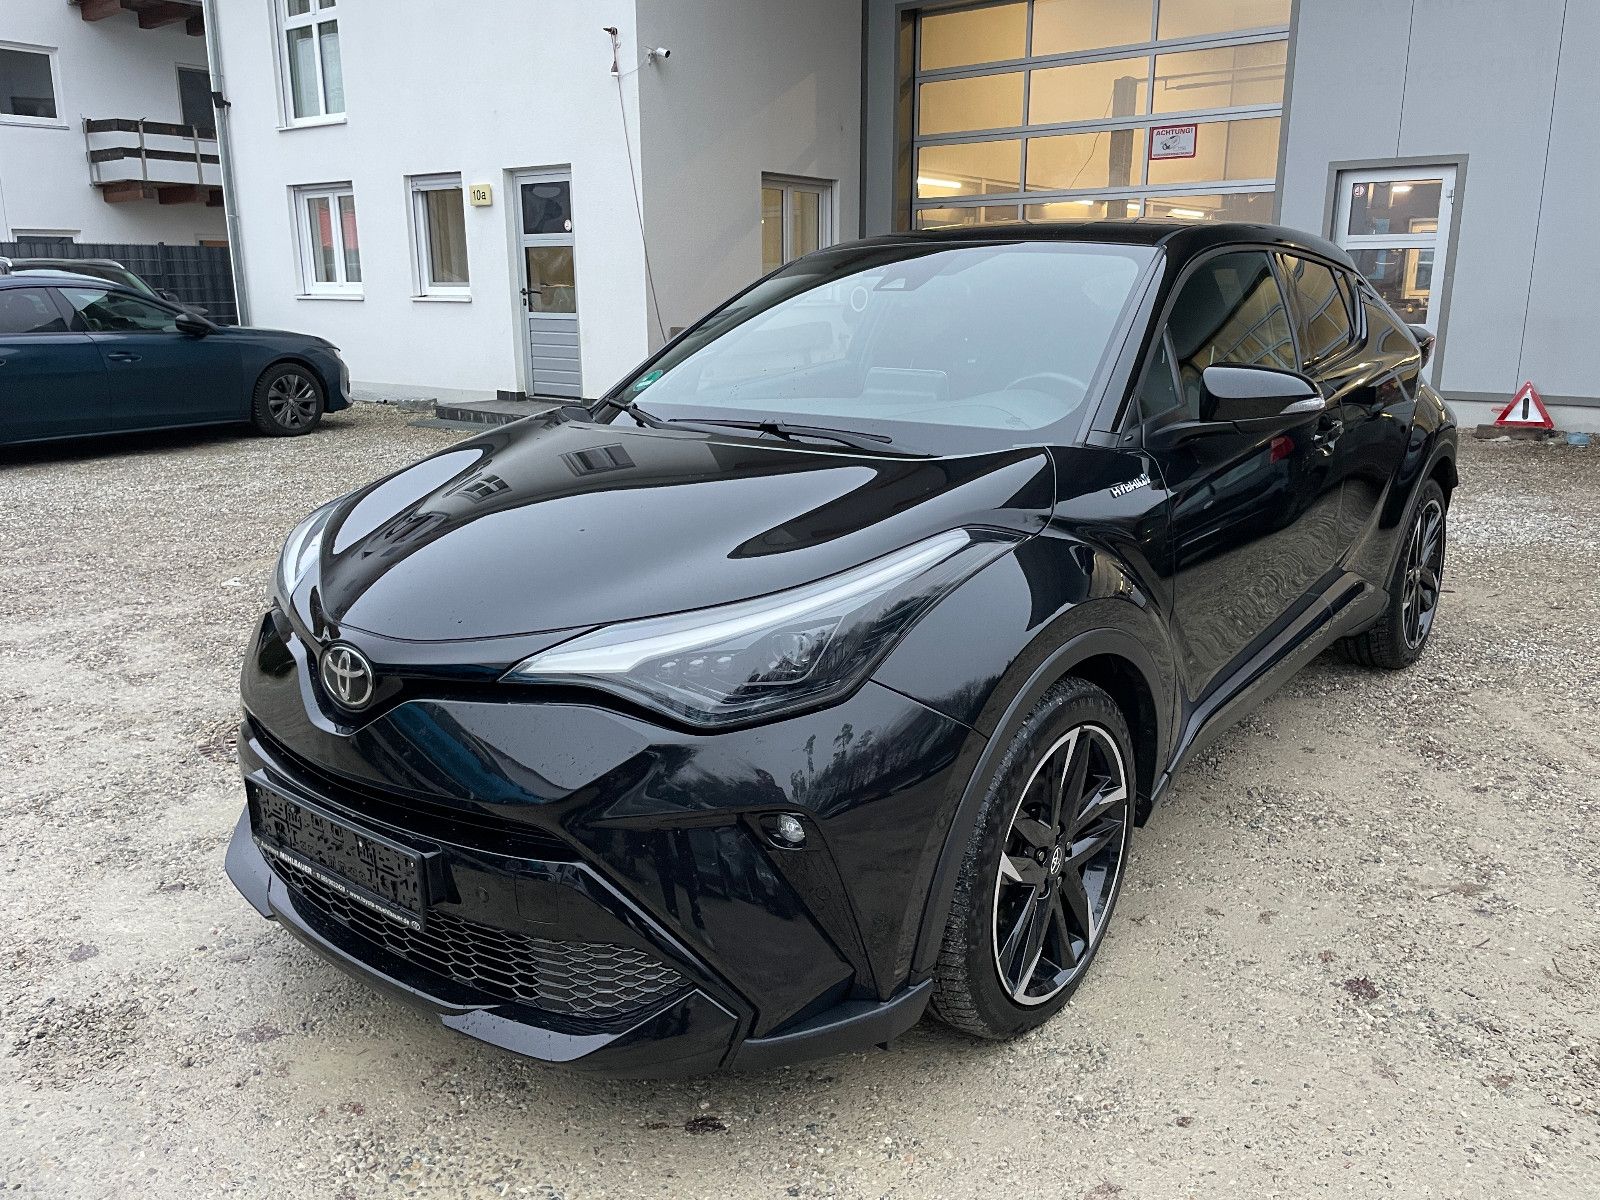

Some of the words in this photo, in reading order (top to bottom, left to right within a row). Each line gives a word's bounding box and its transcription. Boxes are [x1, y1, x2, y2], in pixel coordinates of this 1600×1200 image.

[1155, 127, 1194, 136] ACHTUNG!
[472, 189, 487, 201] 10a
[280, 850, 313, 875] MÜHLBAUER
